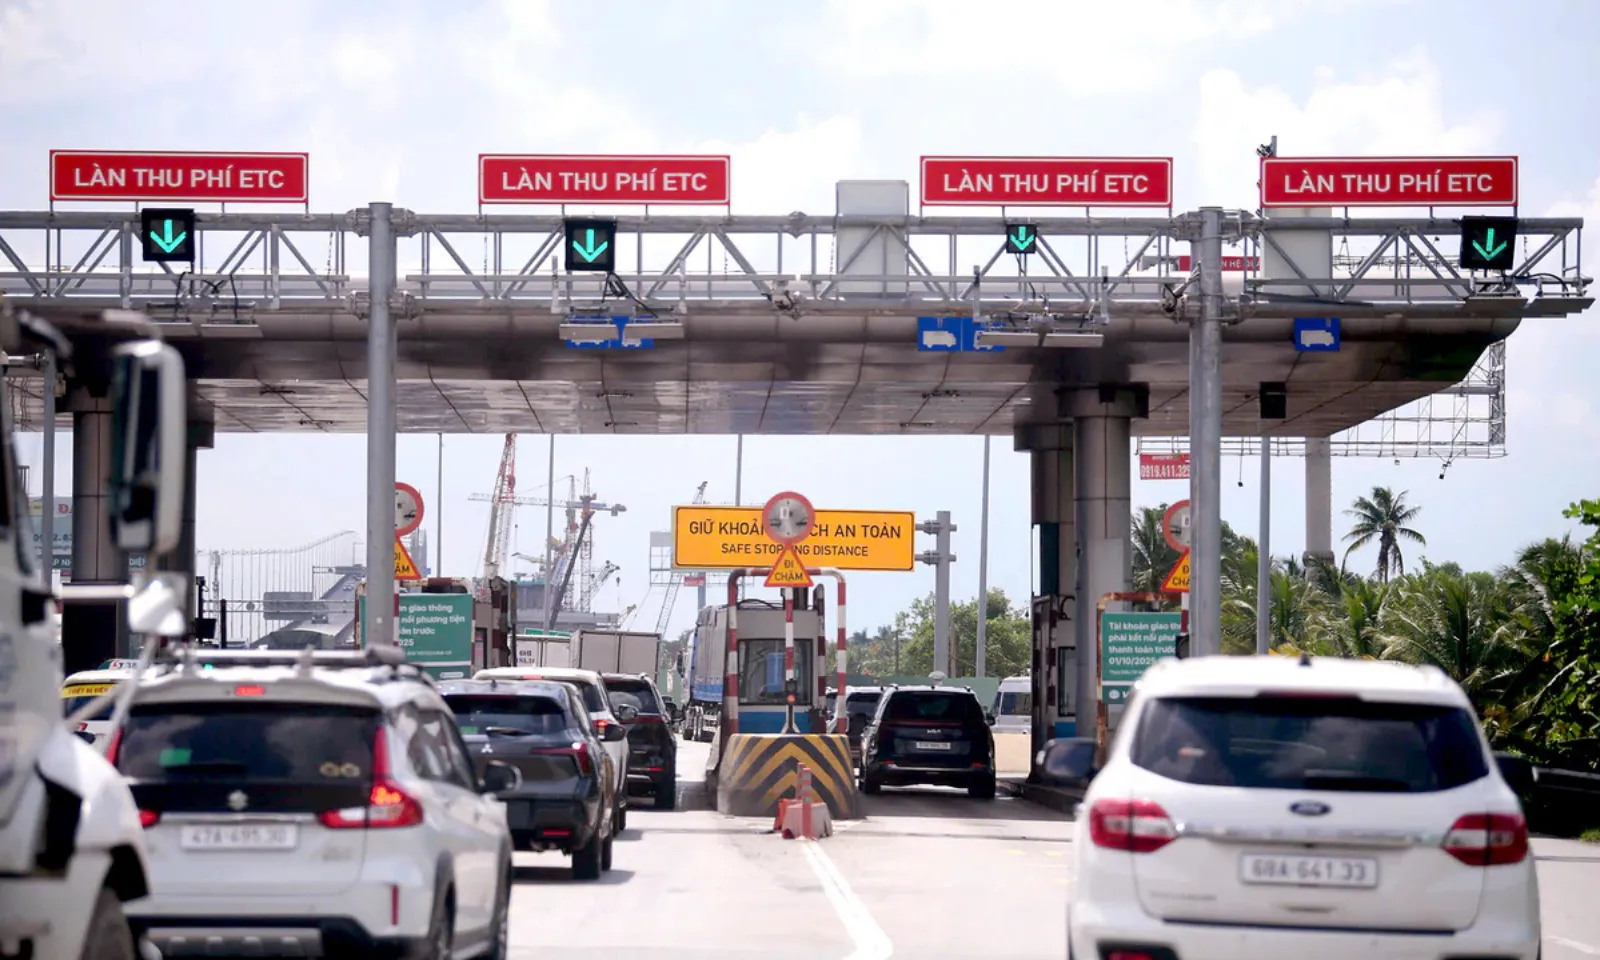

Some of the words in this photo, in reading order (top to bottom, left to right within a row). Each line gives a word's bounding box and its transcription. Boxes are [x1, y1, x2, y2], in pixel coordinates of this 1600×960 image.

[74, 163, 126, 187] LÀN
[132, 168, 183, 188] THU
[190, 164, 233, 188] PHÍ
[239, 169, 285, 189] ETC
[502, 167, 552, 190] LÀN
[558, 172, 608, 191] THU
[615, 168, 657, 191] PHÍ
[662, 172, 707, 192] ETC
[943, 169, 993, 193] LÀN
[999, 173, 1049, 193] THU
[1056, 169, 1099, 193] PHÍ
[1104, 174, 1149, 193] ETC
[1284, 169, 1334, 193] LÀN
[1341, 174, 1391, 193] THU
[1399, 169, 1441, 193] PHÍ
[1448, 174, 1493, 193] ETC
[689, 518, 715, 535] GIỮ
[834, 524, 856, 538] AN
[861, 522, 901, 539] TOÀN
[721, 543, 751, 554] SAFE
[754, 543, 810, 556] STOPNG
[813, 545, 868, 557] DISTANCE
[408, 605, 427, 613] giao
[428, 604, 453, 613] thông
[1150, 622, 1169, 631] giao
